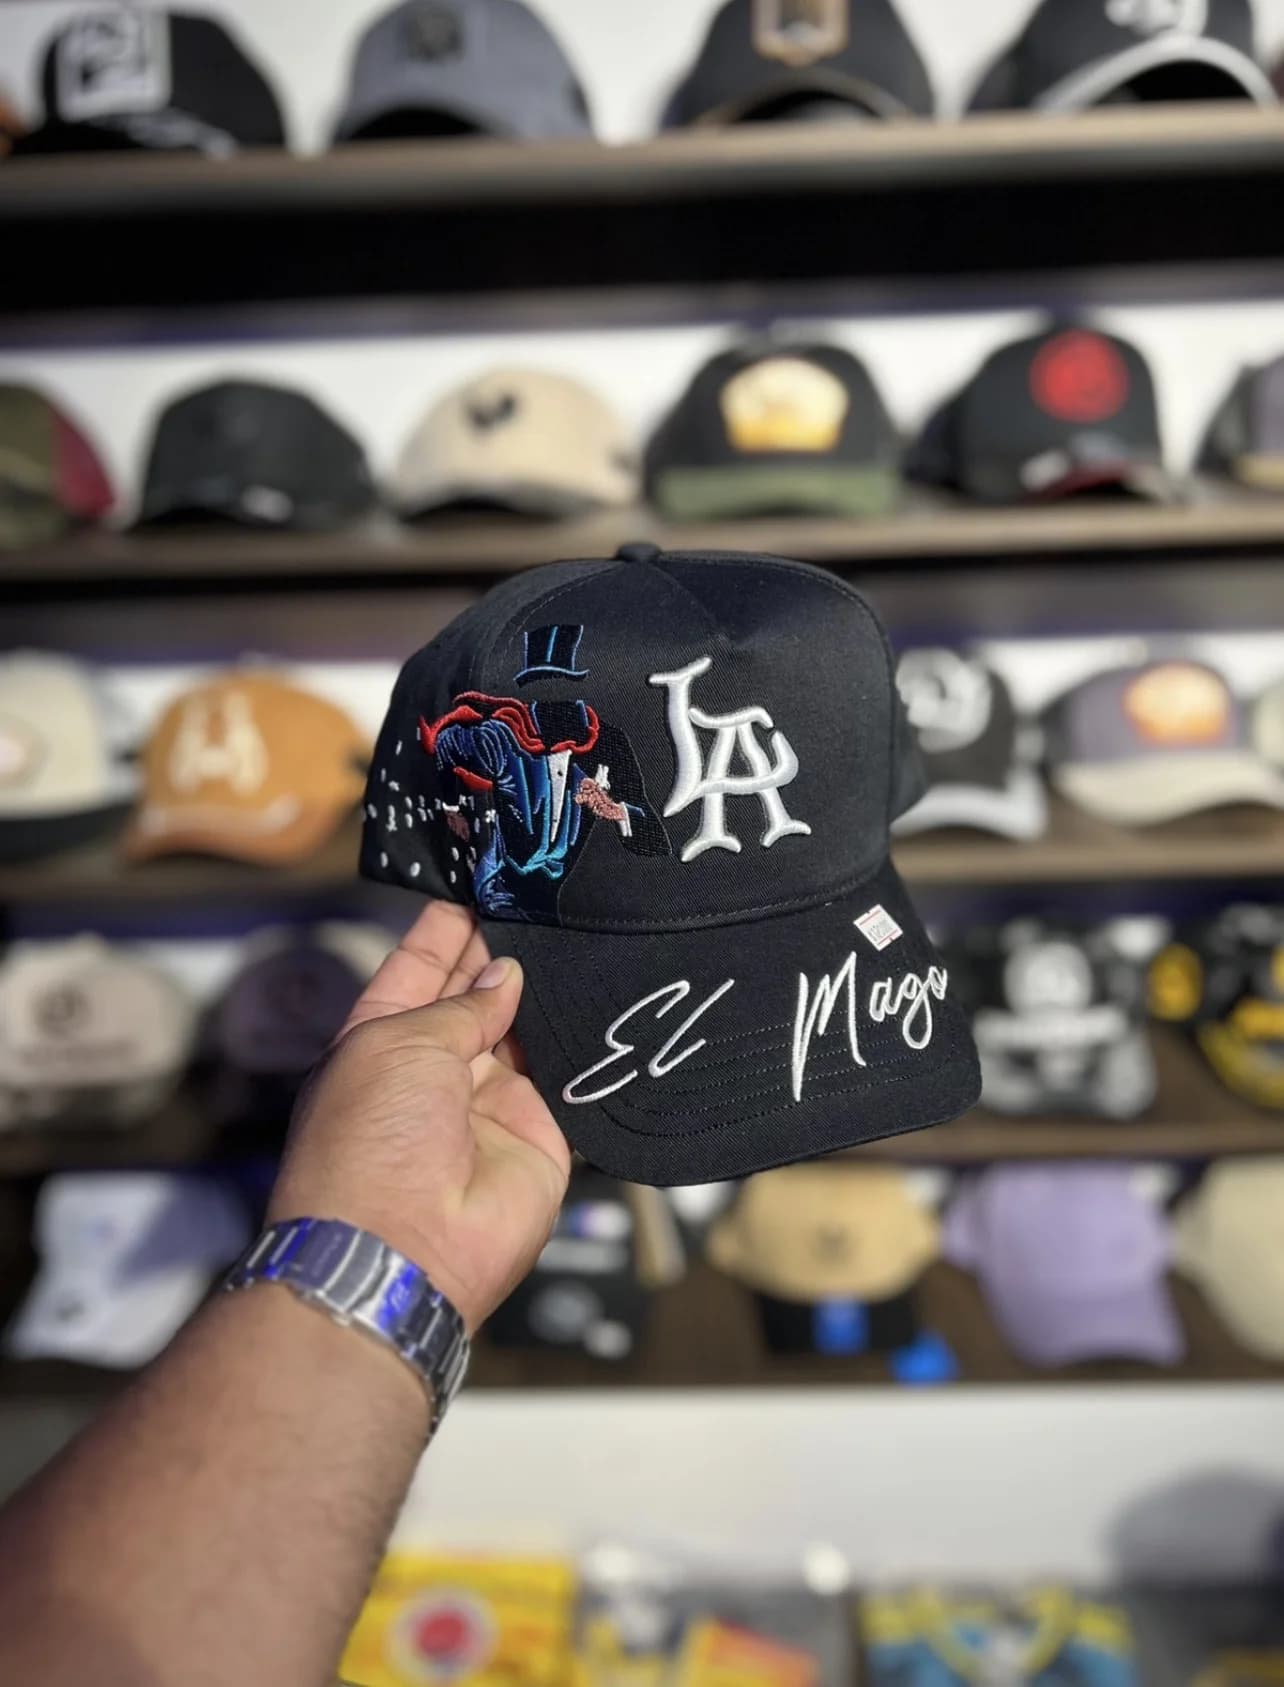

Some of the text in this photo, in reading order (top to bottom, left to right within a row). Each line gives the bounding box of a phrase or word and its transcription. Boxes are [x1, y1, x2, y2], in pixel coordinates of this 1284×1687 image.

[648, 656, 811, 862] LA
[563, 951, 947, 1103] El Mago
